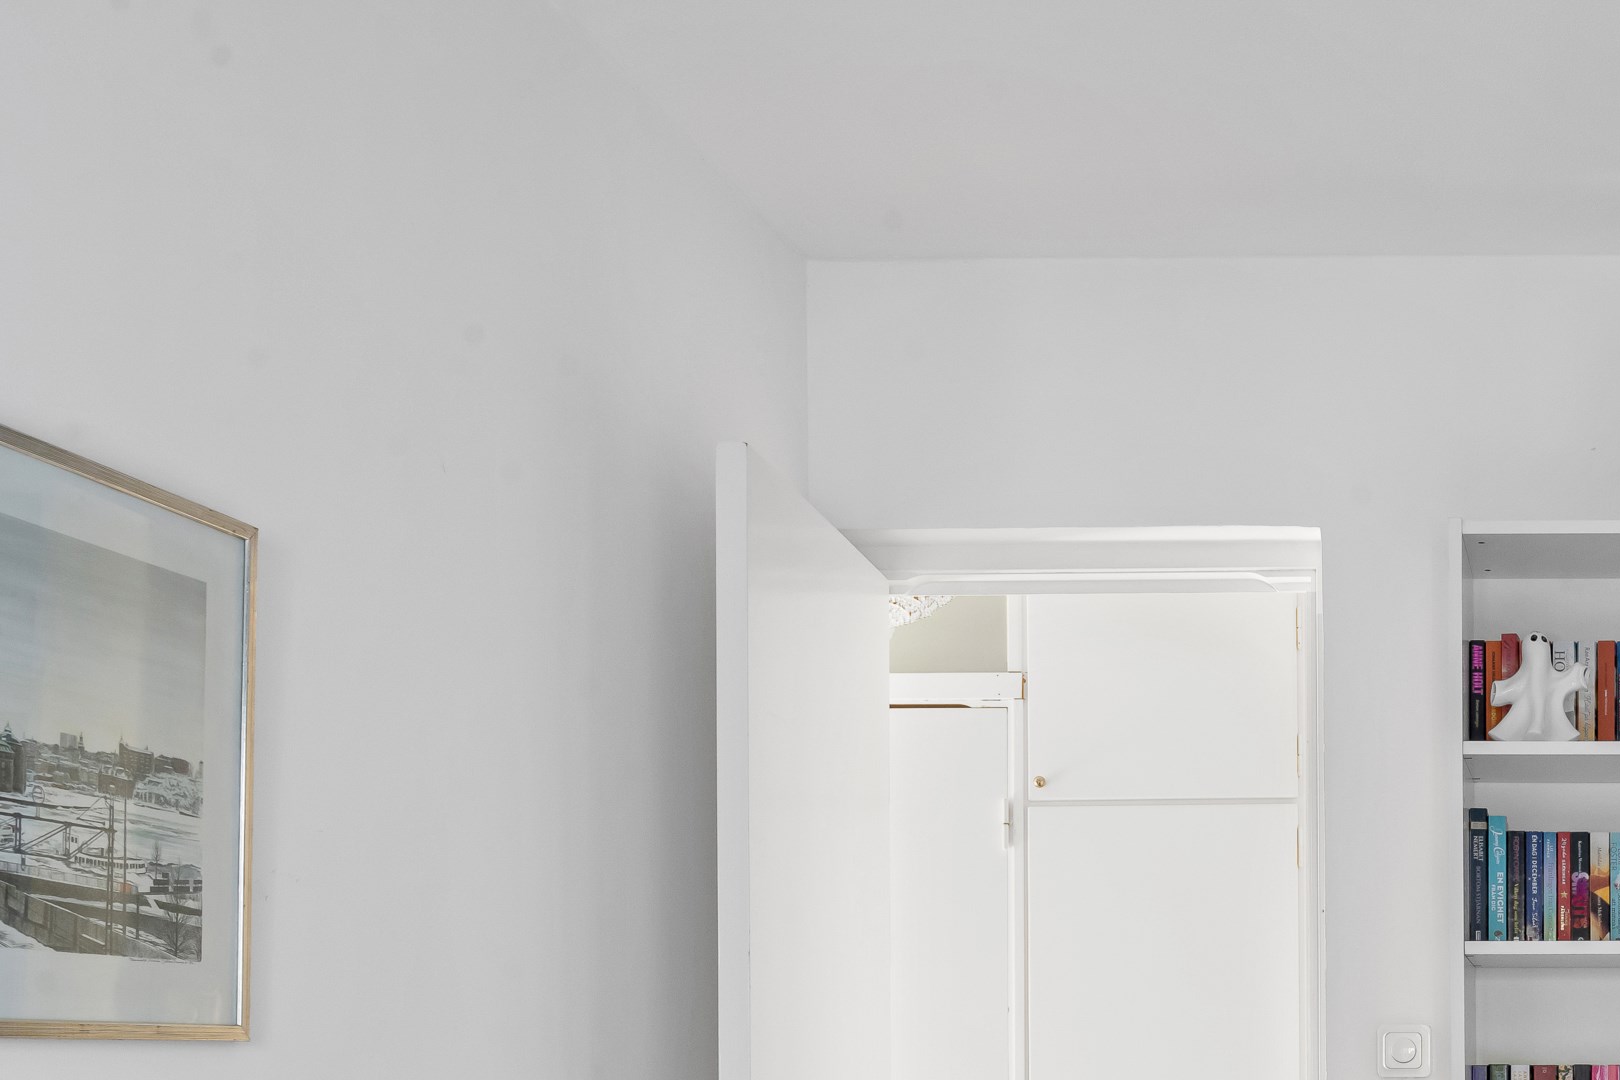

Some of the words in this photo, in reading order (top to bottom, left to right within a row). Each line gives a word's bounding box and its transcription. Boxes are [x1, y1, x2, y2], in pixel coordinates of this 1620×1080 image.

[1472, 645, 1482, 670] ANNE
[1472, 672, 1482, 695] HOLT
[1497, 872, 1503, 883] EN
